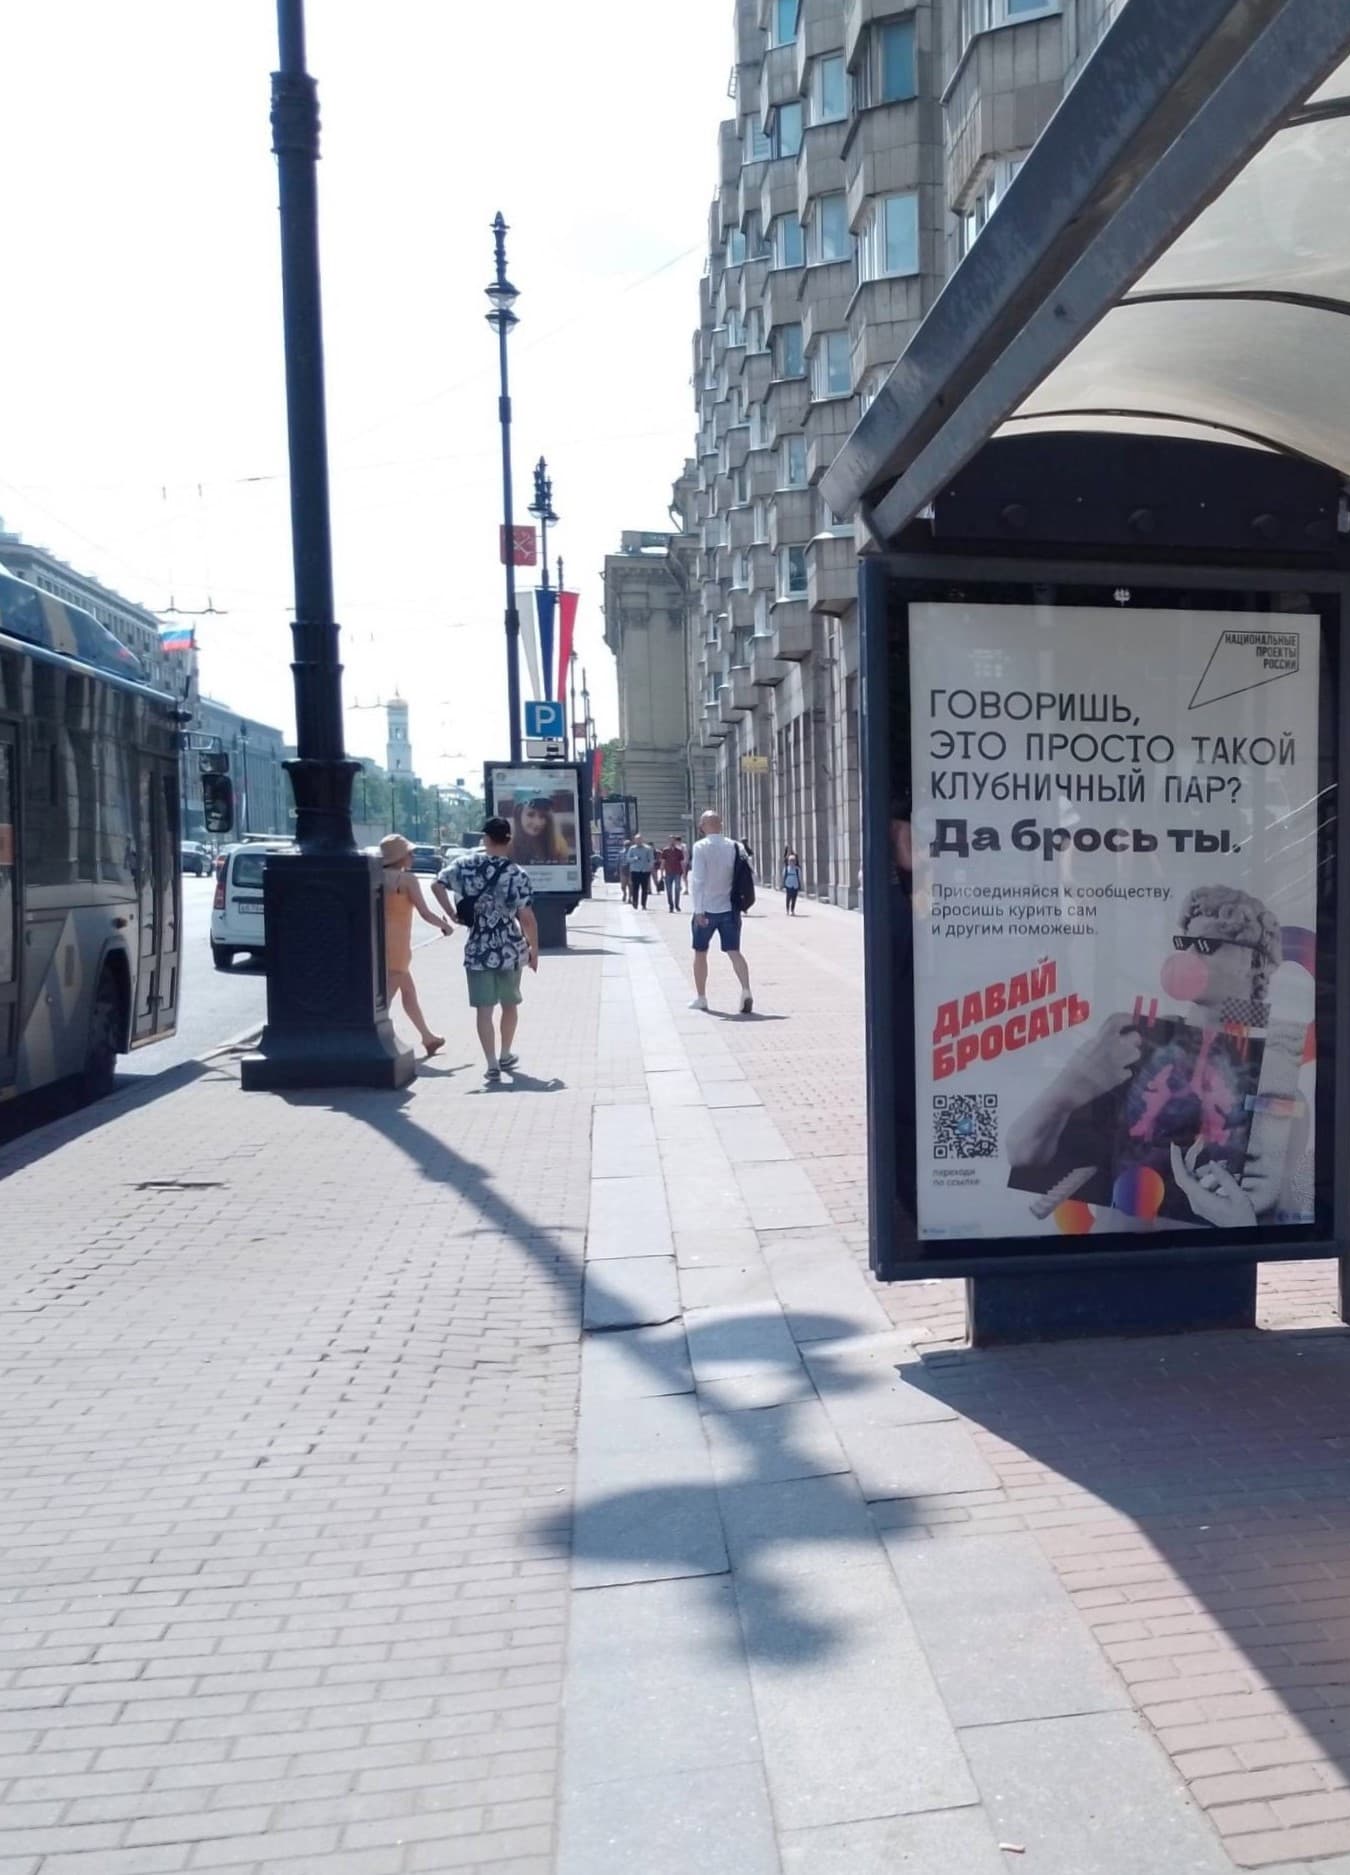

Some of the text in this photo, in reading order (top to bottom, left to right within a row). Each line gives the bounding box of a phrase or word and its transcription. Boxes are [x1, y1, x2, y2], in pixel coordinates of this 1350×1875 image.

[1224, 633, 1297, 646] НАЦИОНАЛЬНЫЕ
[1256, 646, 1297, 658] ПРОЕКТЫ
[1263, 658, 1297, 669] РОССИИ
[534, 705, 556, 734] P
[930, 689, 1140, 726] ГОВОРИШЬ,
[930, 730, 1295, 766] ЭТО ПРОСТО ТАКОЙ
[1165, 776, 1242, 803] ПАР?
[929, 818, 1242, 861] Да брось ты.
[931, 883, 1059, 899] Присоединяйся
[1063, 887, 1073, 898] к
[931, 903, 1097, 919] Бросишь курить сам
[931, 922, 1098, 938] и другим поможешь.
[933, 956, 1056, 1045] ДАВАЙ
[933, 993, 1090, 1081] БРОСАТЬ
